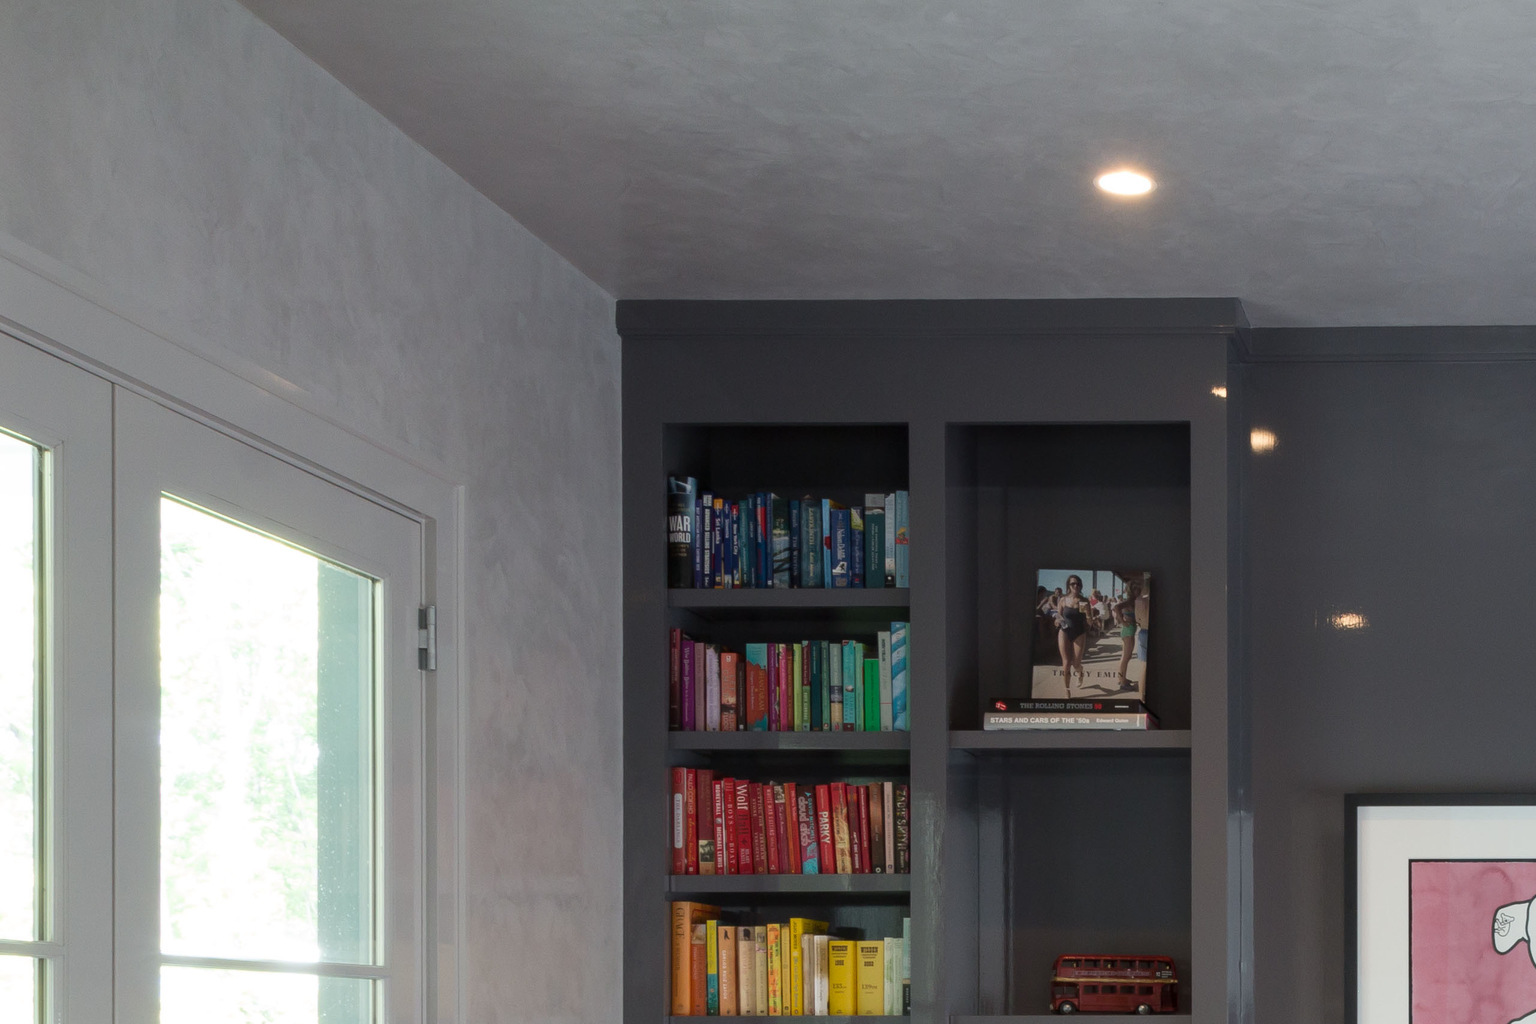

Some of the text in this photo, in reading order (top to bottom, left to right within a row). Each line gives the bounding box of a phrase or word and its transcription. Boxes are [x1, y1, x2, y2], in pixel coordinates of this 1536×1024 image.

[668, 514, 691, 532] WAR
[669, 532, 692, 543] WORLD
[1052, 670, 1124, 679] TRACEY EMIN
[736, 784, 749, 835] Wolf Hall
[798, 796, 811, 846] cloud atlas
[895, 790, 908, 850] ZADIE SMITH
[819, 811, 830, 844] PARKY
